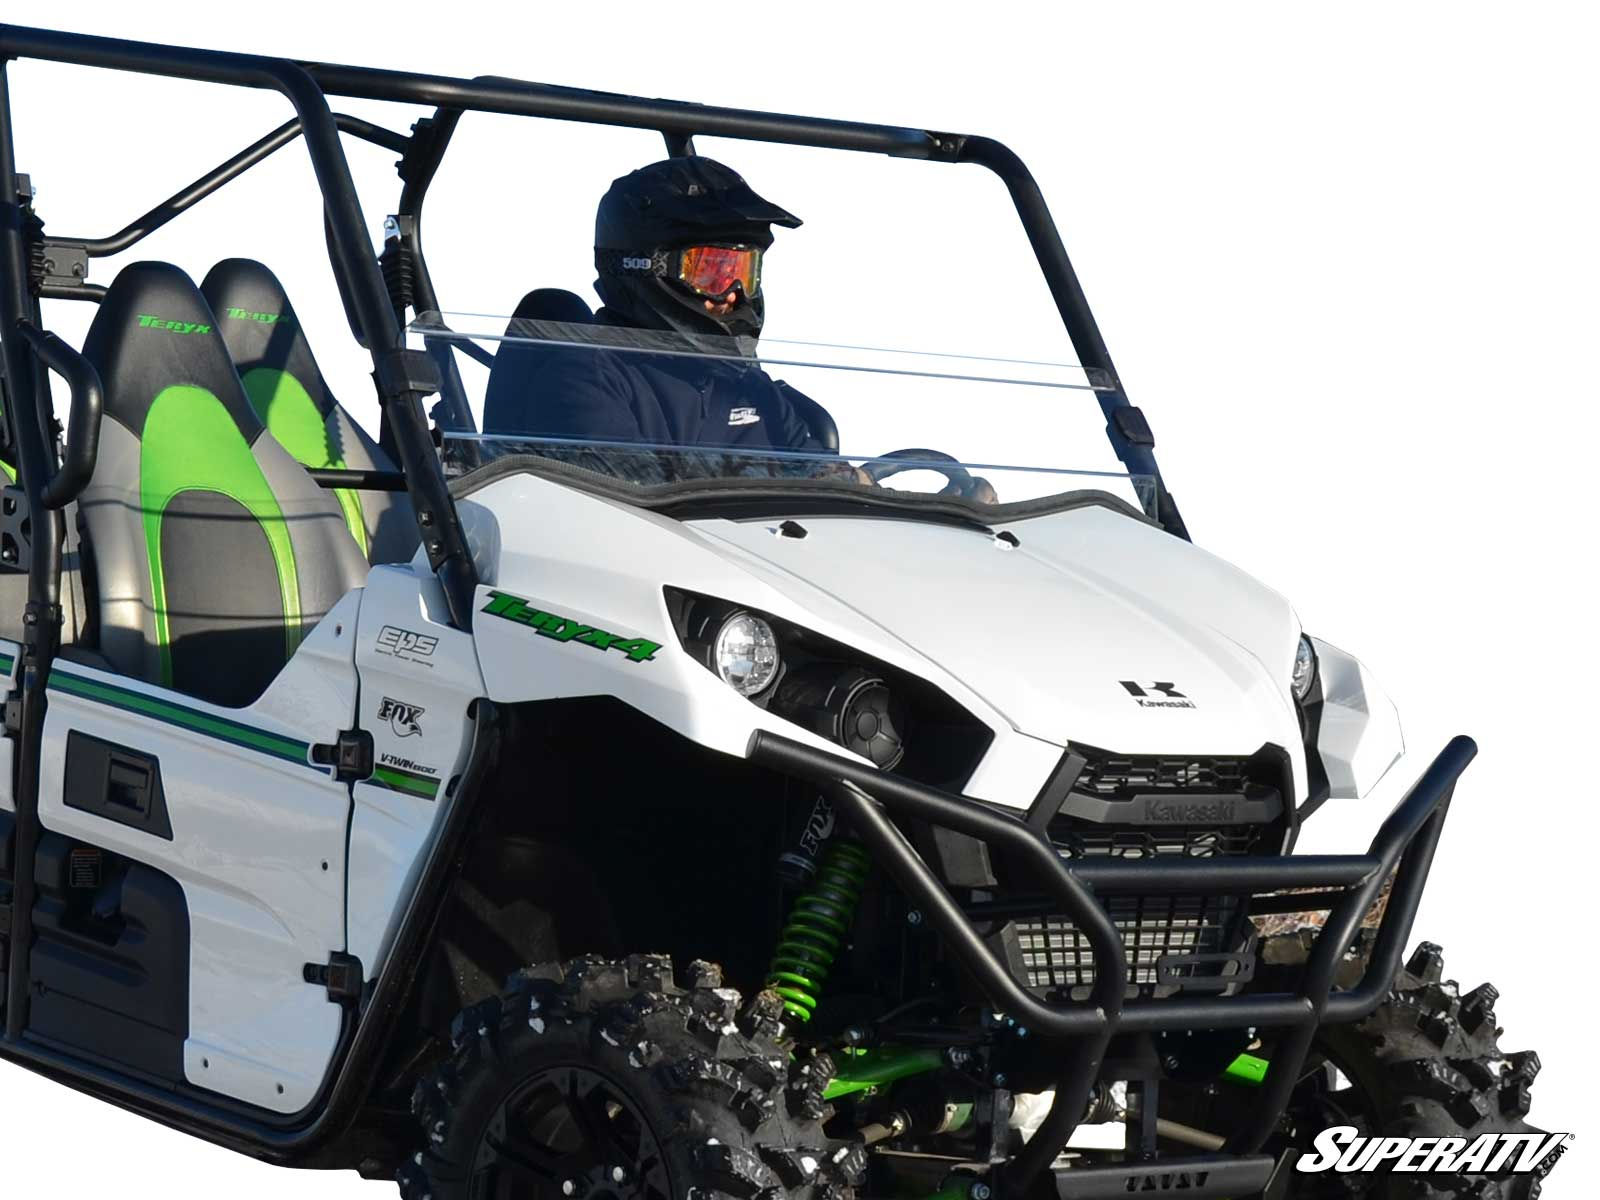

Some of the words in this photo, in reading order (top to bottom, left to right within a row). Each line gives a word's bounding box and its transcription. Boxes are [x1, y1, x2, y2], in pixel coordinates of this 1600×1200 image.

[622, 257, 652, 270] 509
[378, 697, 425, 727] FOX
[1135, 698, 1197, 710] Kawasaki
[1144, 800, 1237, 823] Kawasaki
